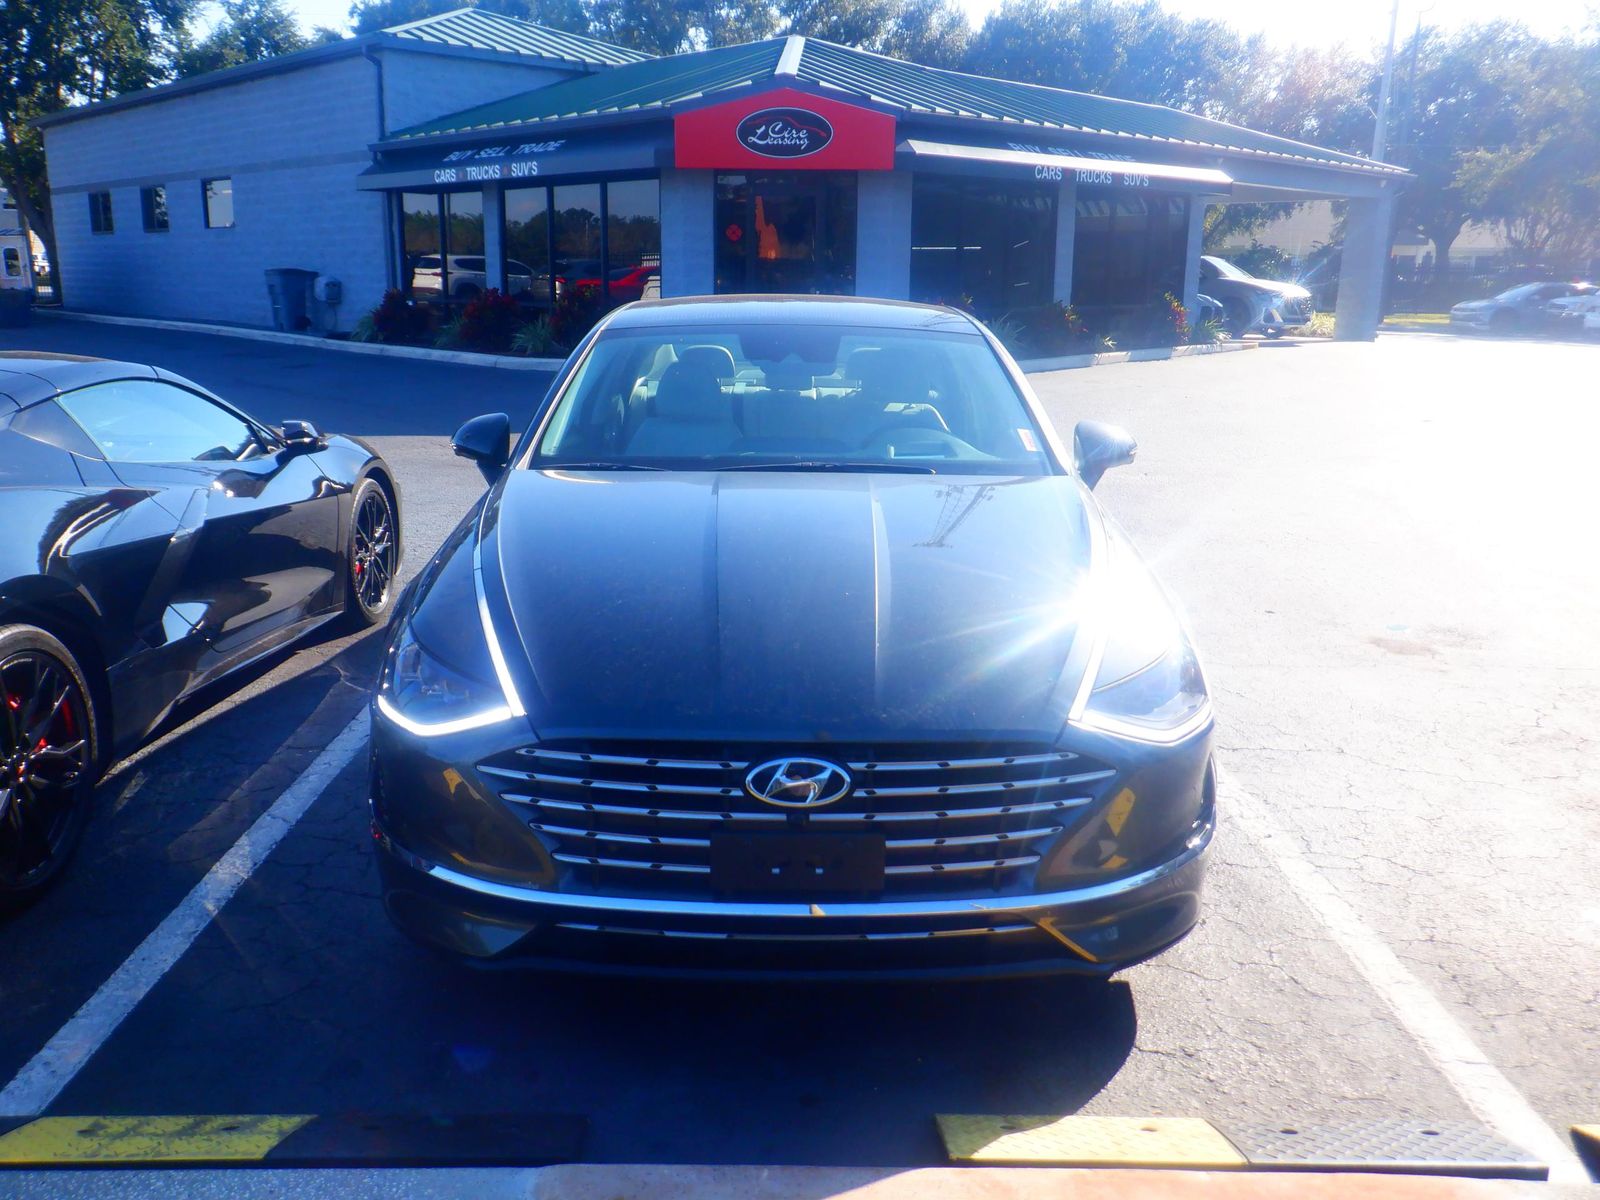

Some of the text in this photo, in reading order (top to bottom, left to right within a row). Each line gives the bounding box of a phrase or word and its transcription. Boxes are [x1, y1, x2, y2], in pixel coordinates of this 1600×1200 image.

[747, 125, 809, 149] Leasing
[768, 121, 808, 138] Cire
[443, 140, 567, 161] BUY SELL TRADE
[434, 161, 538, 182] CARS TRUCKS SUV'S
[1035, 164, 1149, 187] CARS TRUCKS SUV'S
